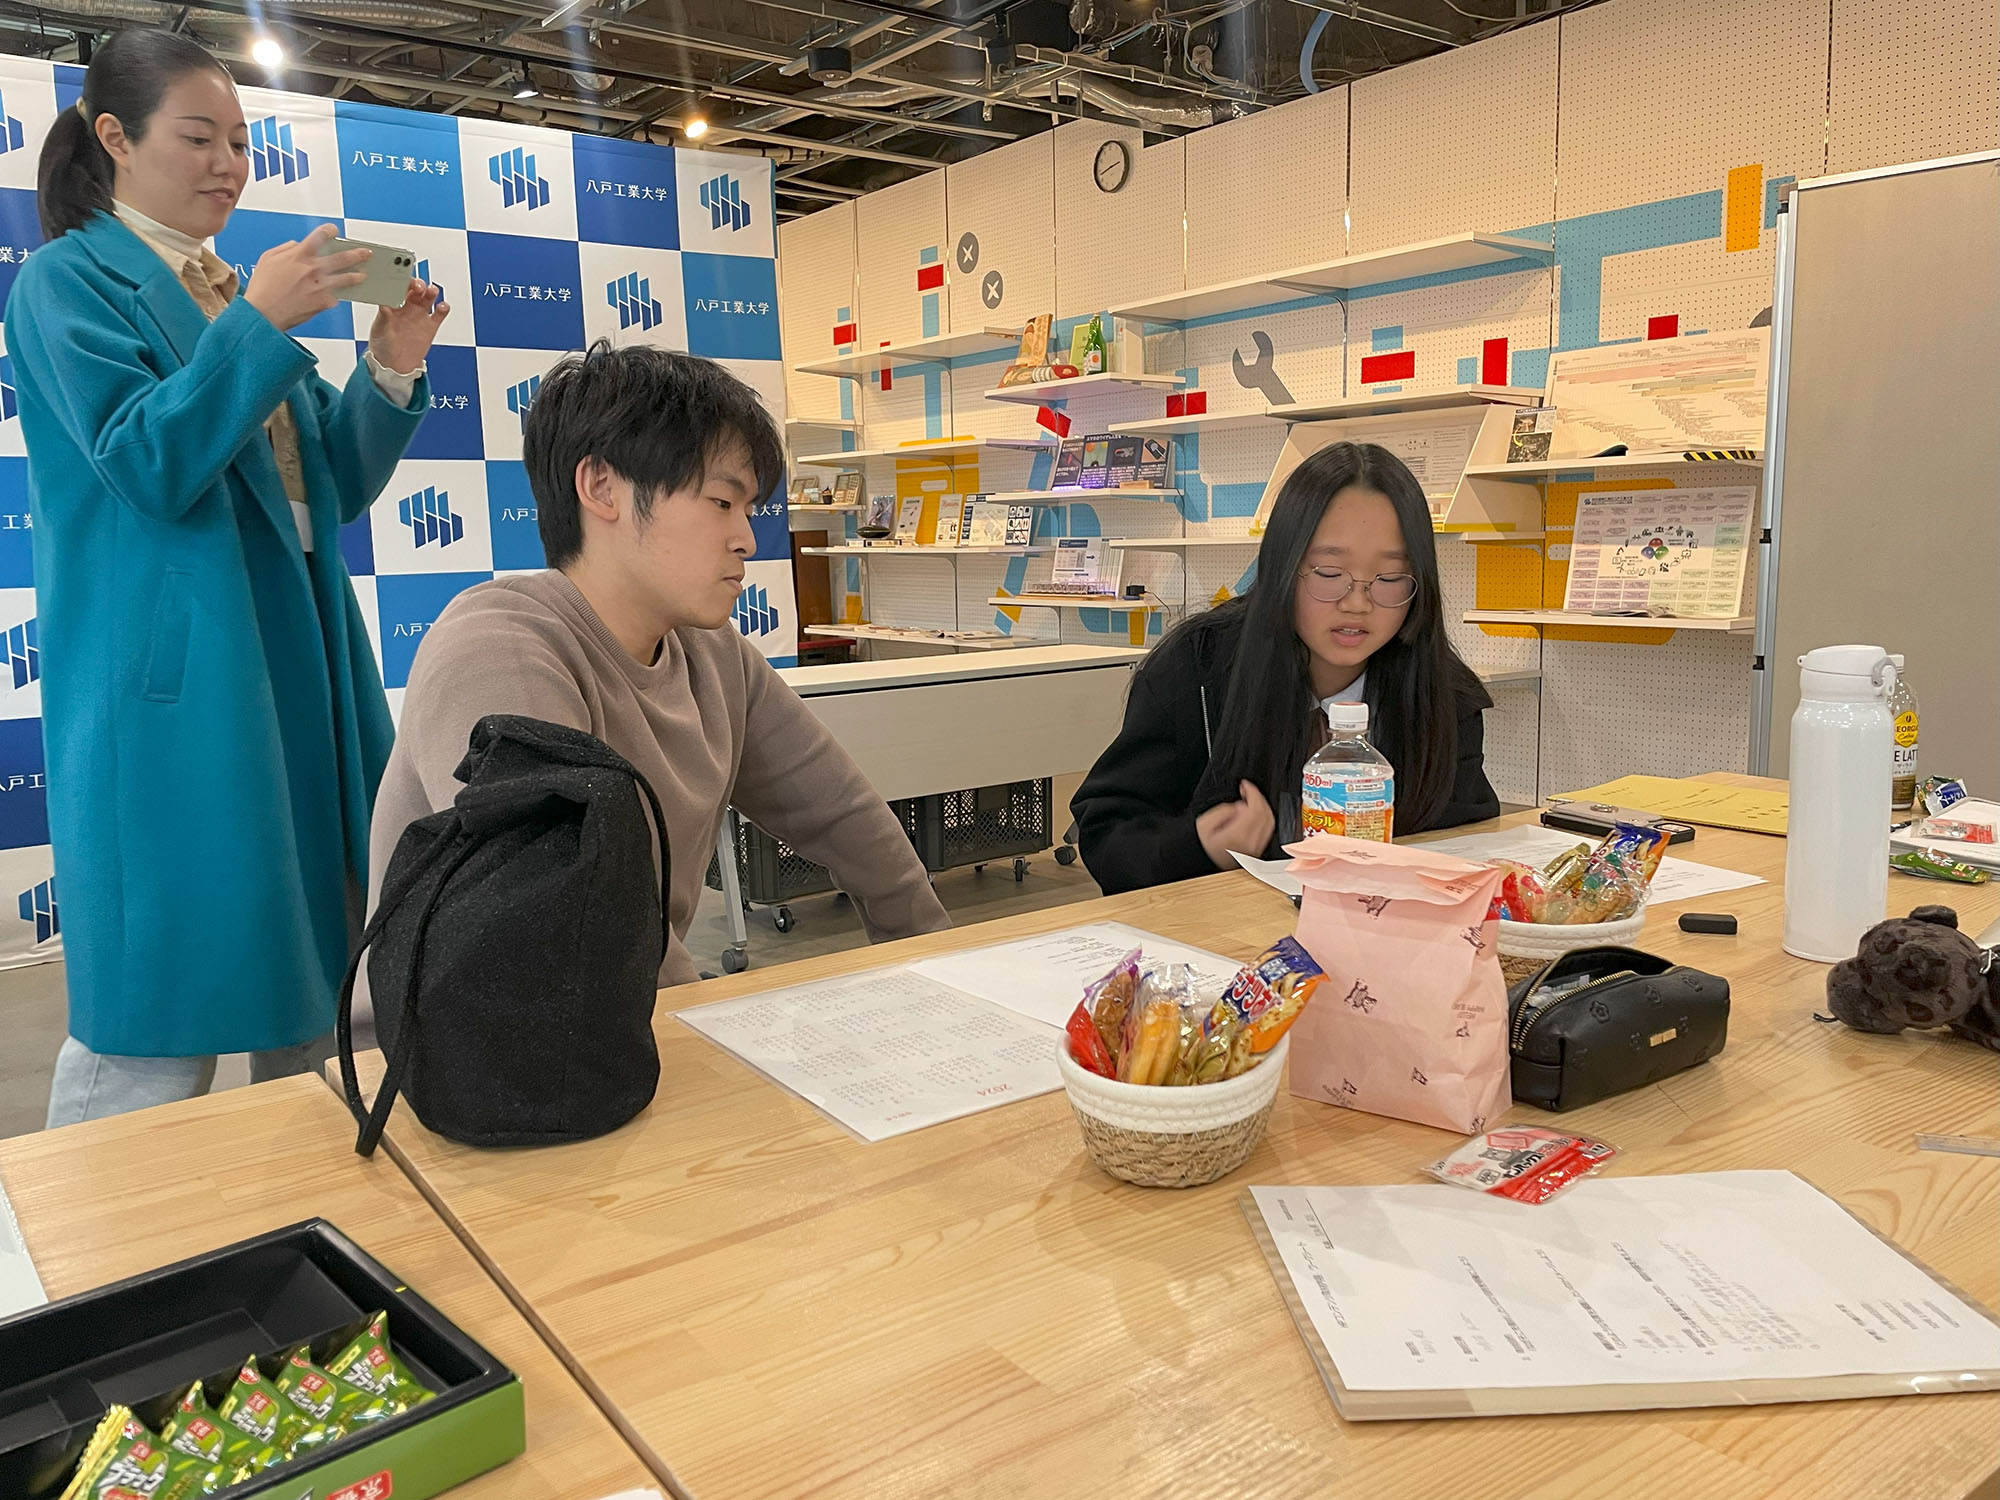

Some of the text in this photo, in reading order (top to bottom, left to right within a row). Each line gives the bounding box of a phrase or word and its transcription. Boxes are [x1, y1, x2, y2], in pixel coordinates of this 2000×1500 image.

[352, 150, 449, 175] 八戸工業大学
[585, 179, 667, 201] 八戸工業大学
[484, 282, 572, 302] 八戸工業大学
[695, 298, 770, 315] 八戸工業大学
[394, 622, 432, 637] 八戸
